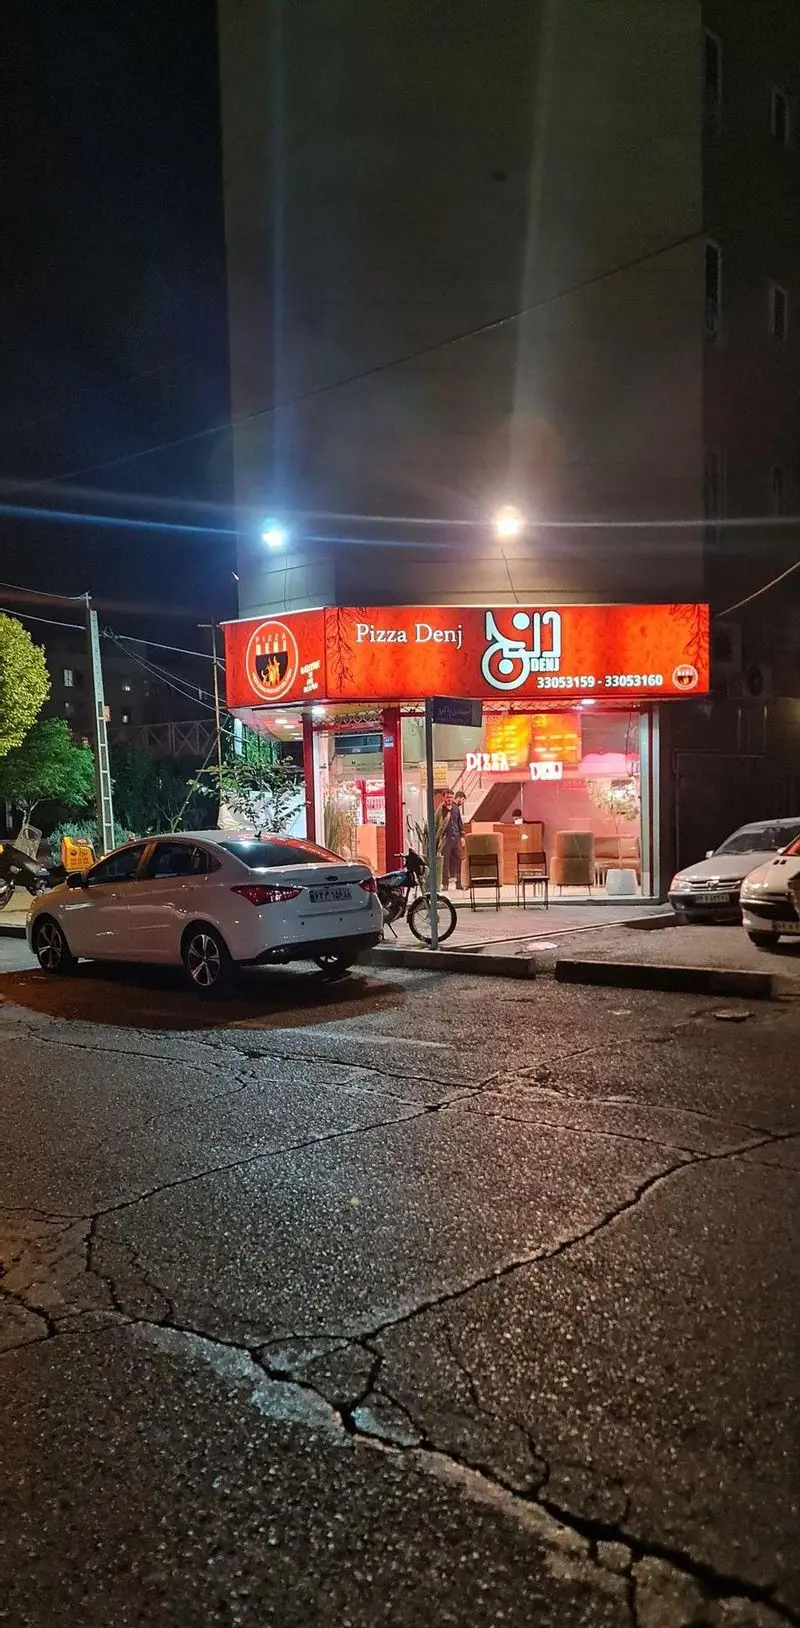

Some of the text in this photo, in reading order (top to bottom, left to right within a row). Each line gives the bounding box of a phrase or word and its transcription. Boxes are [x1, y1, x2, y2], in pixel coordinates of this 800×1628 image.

[356, 623, 463, 649] Pizza Denj
[530, 658, 560, 672] DENJ
[536, 675, 595, 689] 33053159
[604, 674, 663, 688] 33053160
